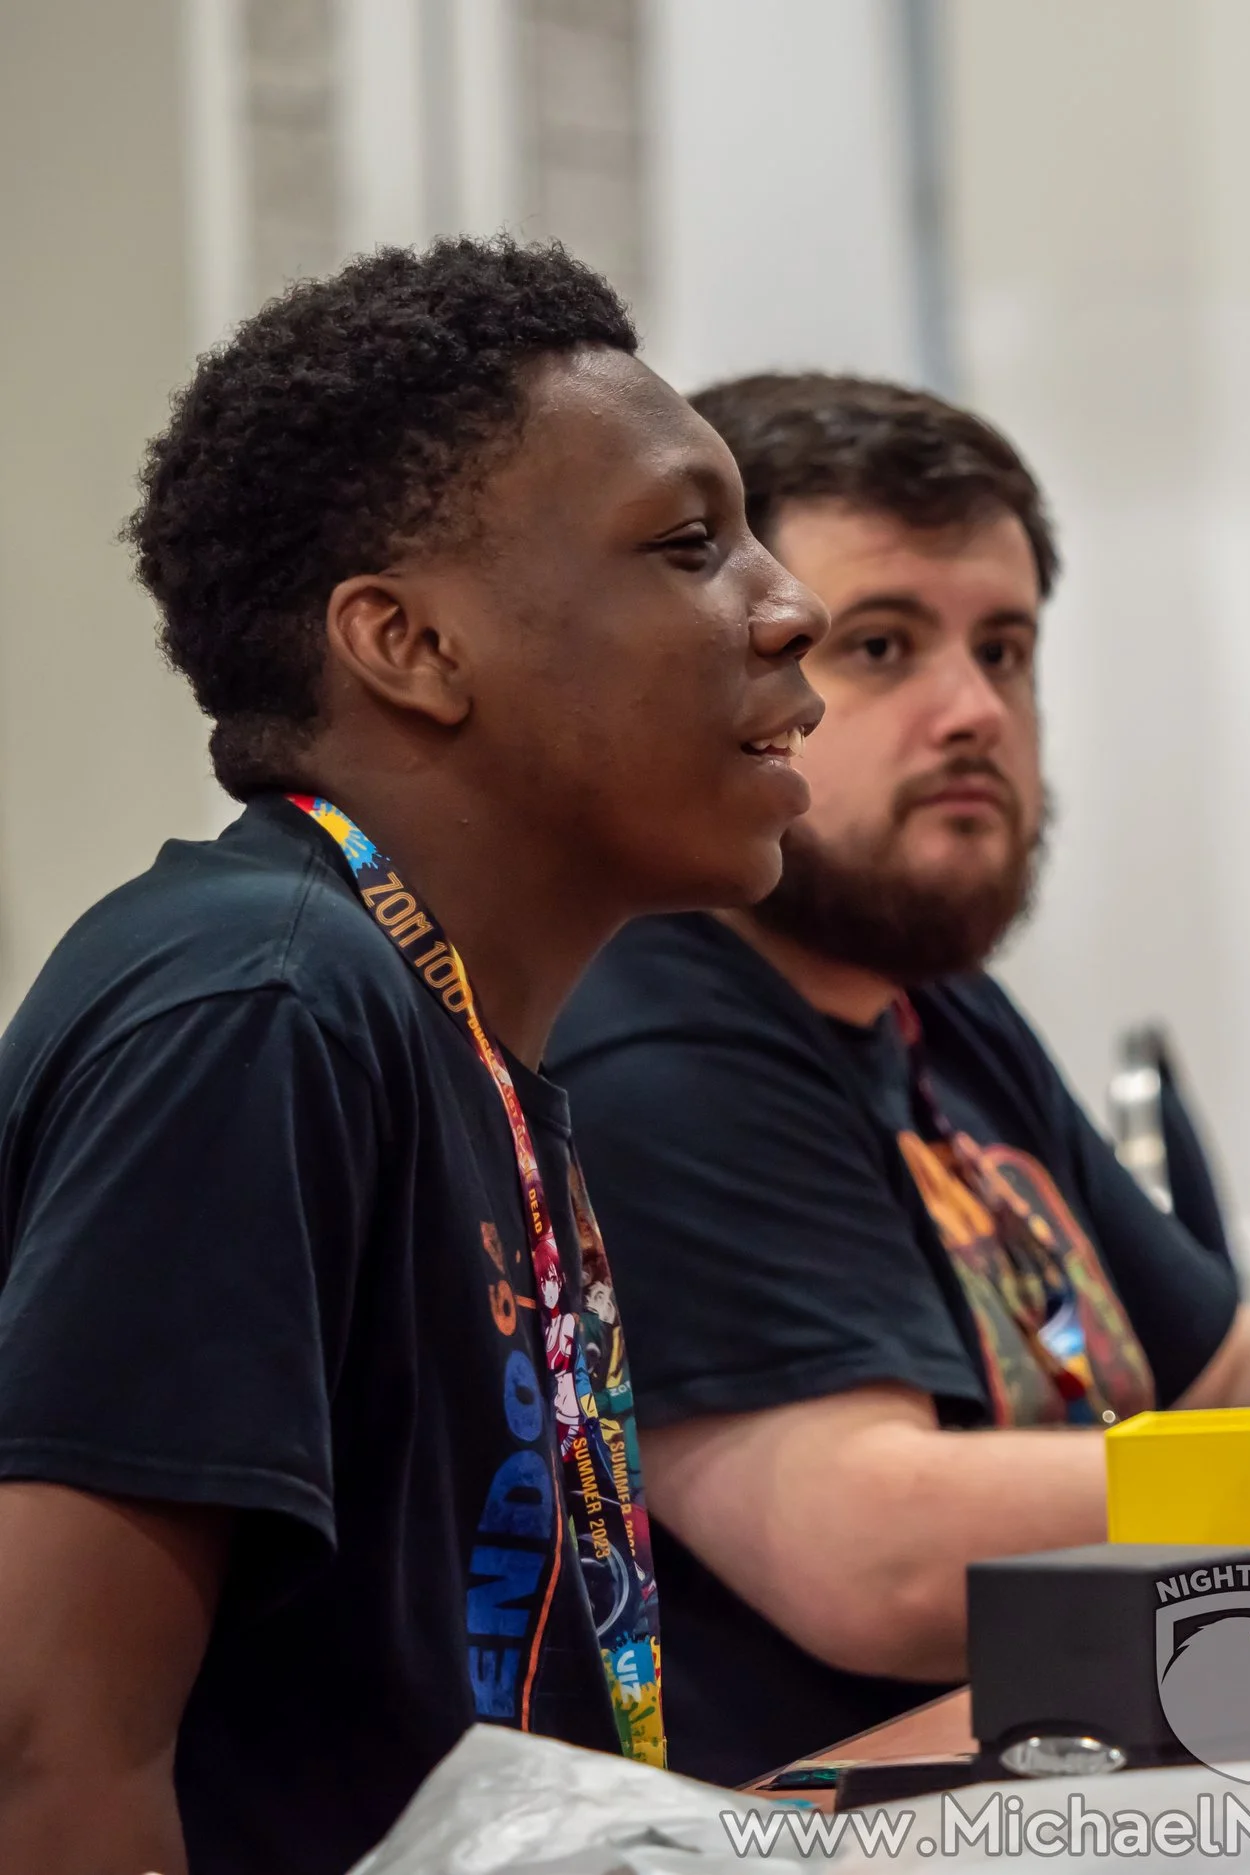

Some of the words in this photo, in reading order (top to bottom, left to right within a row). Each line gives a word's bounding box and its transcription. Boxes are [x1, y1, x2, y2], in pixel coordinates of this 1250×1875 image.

[361, 871, 435, 948] ZOM
[414, 940, 473, 1013] 100
[528, 1187, 543, 1234] DEAD
[573, 1437, 602, 1515] SUMMER
[589, 1518, 612, 1559] 2023
[617, 1649, 642, 1704] VIZ
